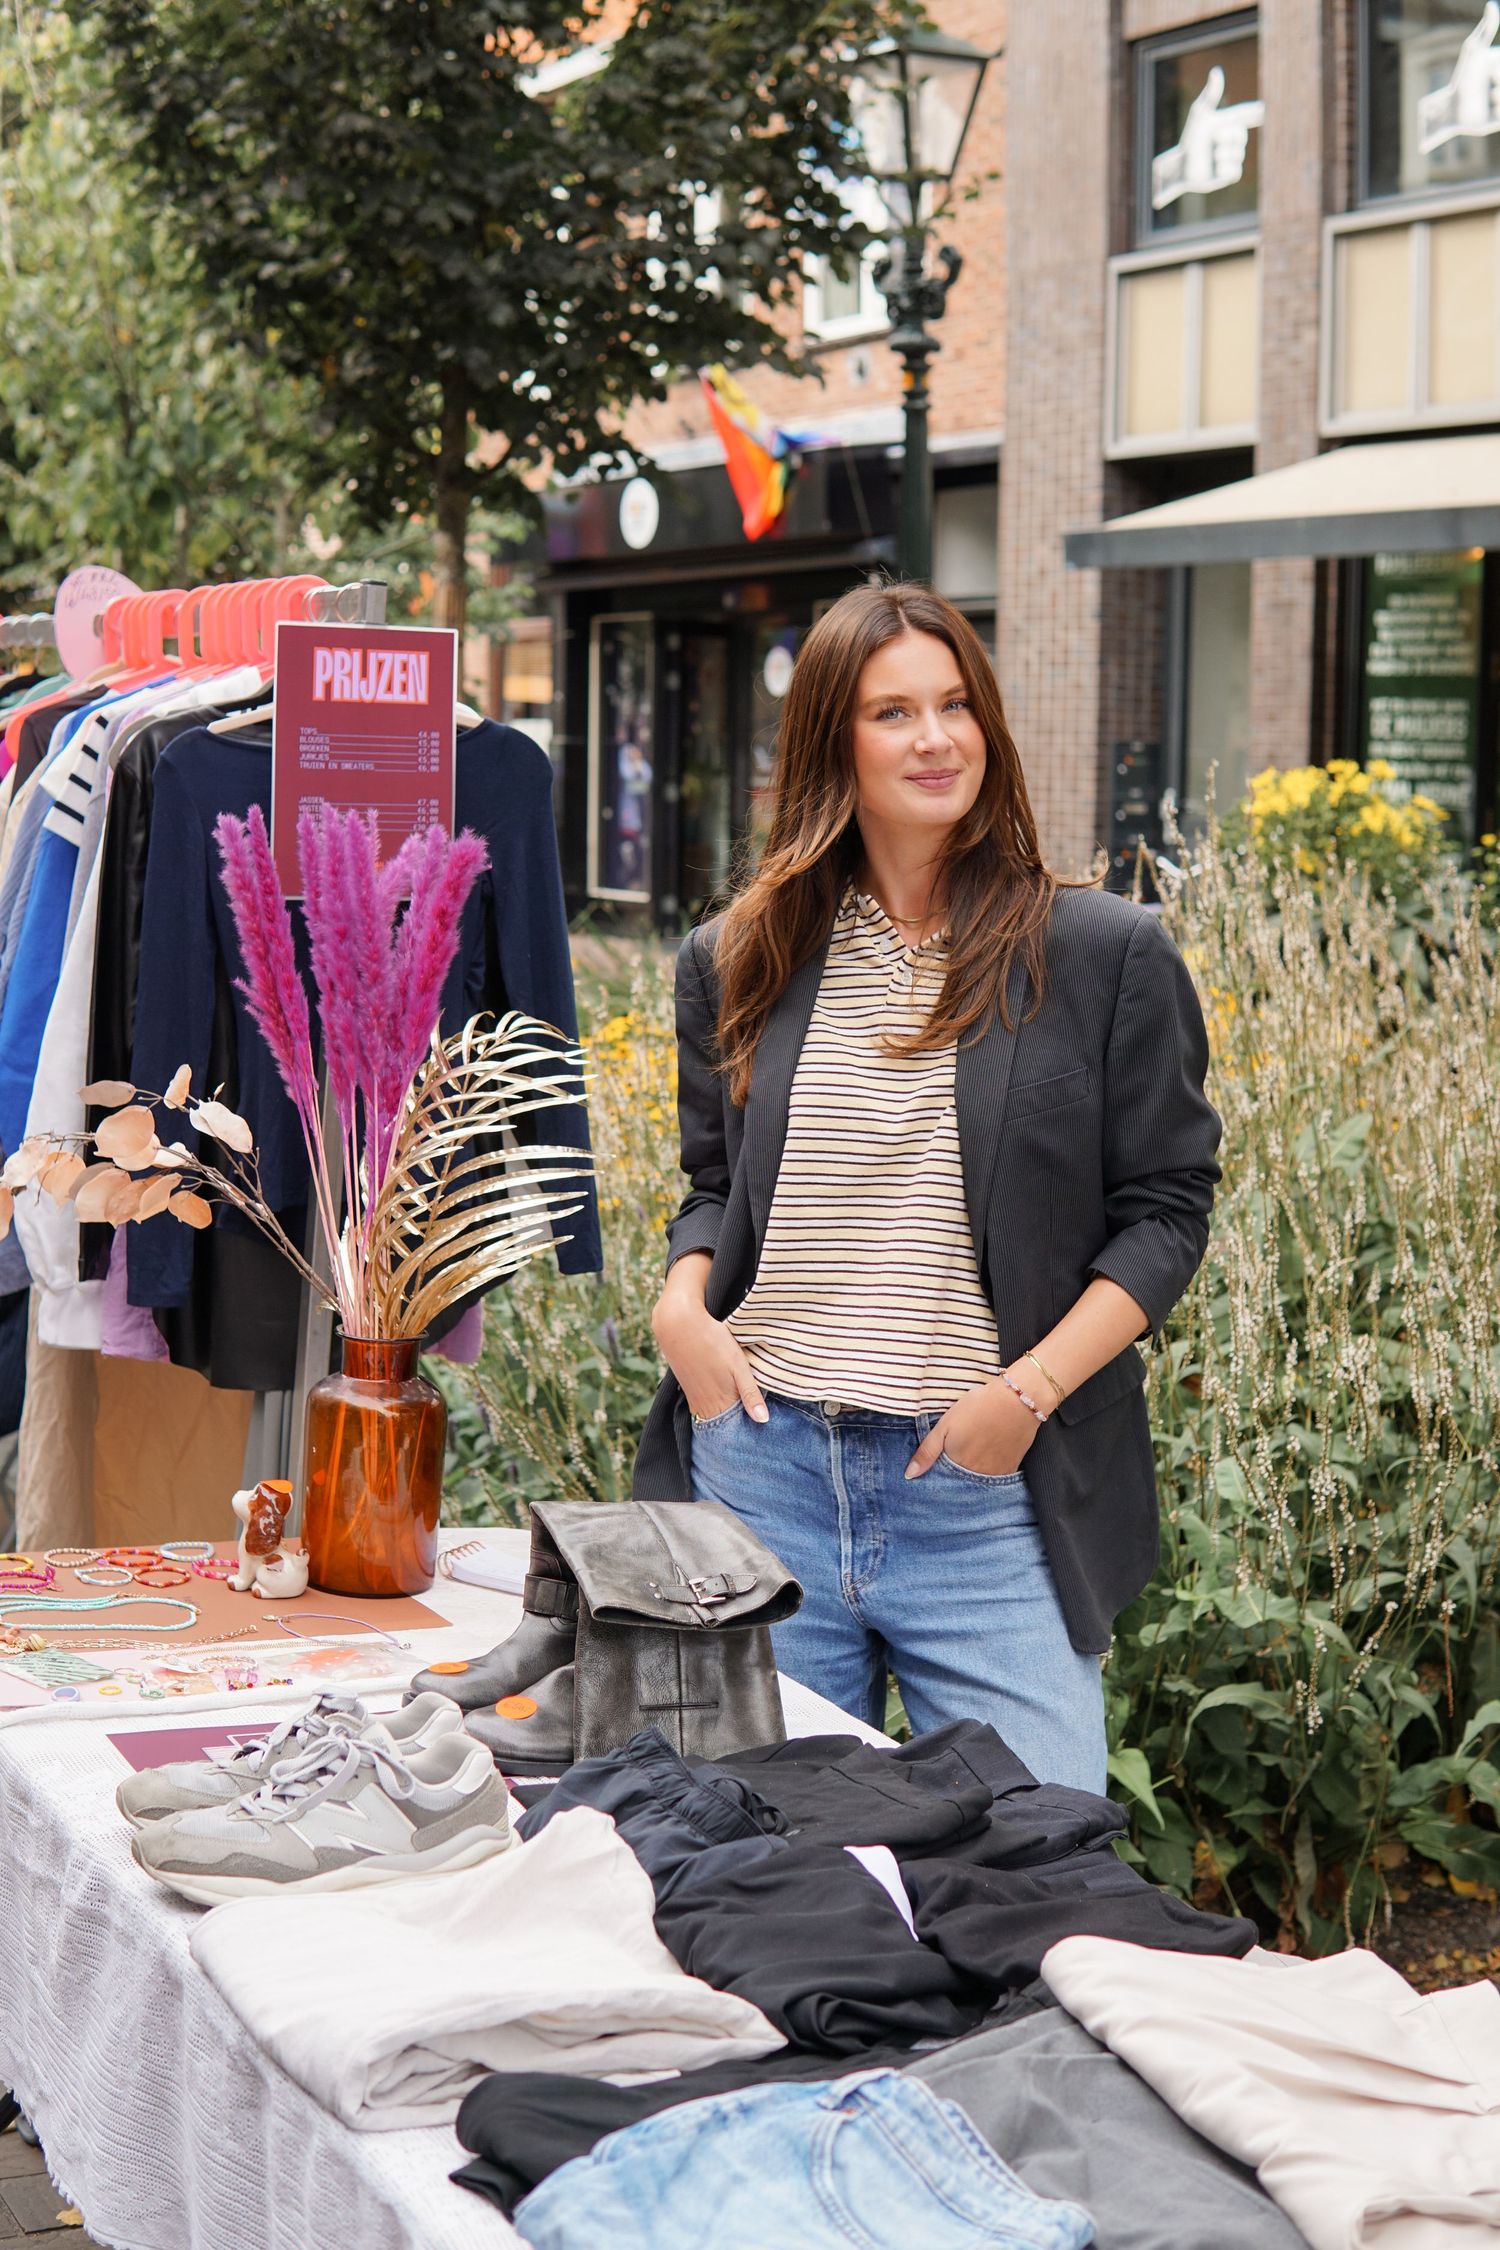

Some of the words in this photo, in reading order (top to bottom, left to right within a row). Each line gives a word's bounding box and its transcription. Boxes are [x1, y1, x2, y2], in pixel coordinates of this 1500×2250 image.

[312, 646, 430, 705] PRIJZEN
[299, 727, 318, 736] TOPS
[299, 735, 330, 744] BLOUSES
[299, 744, 330, 753] BROEKEN
[299, 752, 330, 761] JURKJES
[299, 761, 326, 770] TRUIEN
[327, 761, 338, 770] EN
[340, 762, 375, 771] SWEATERS
